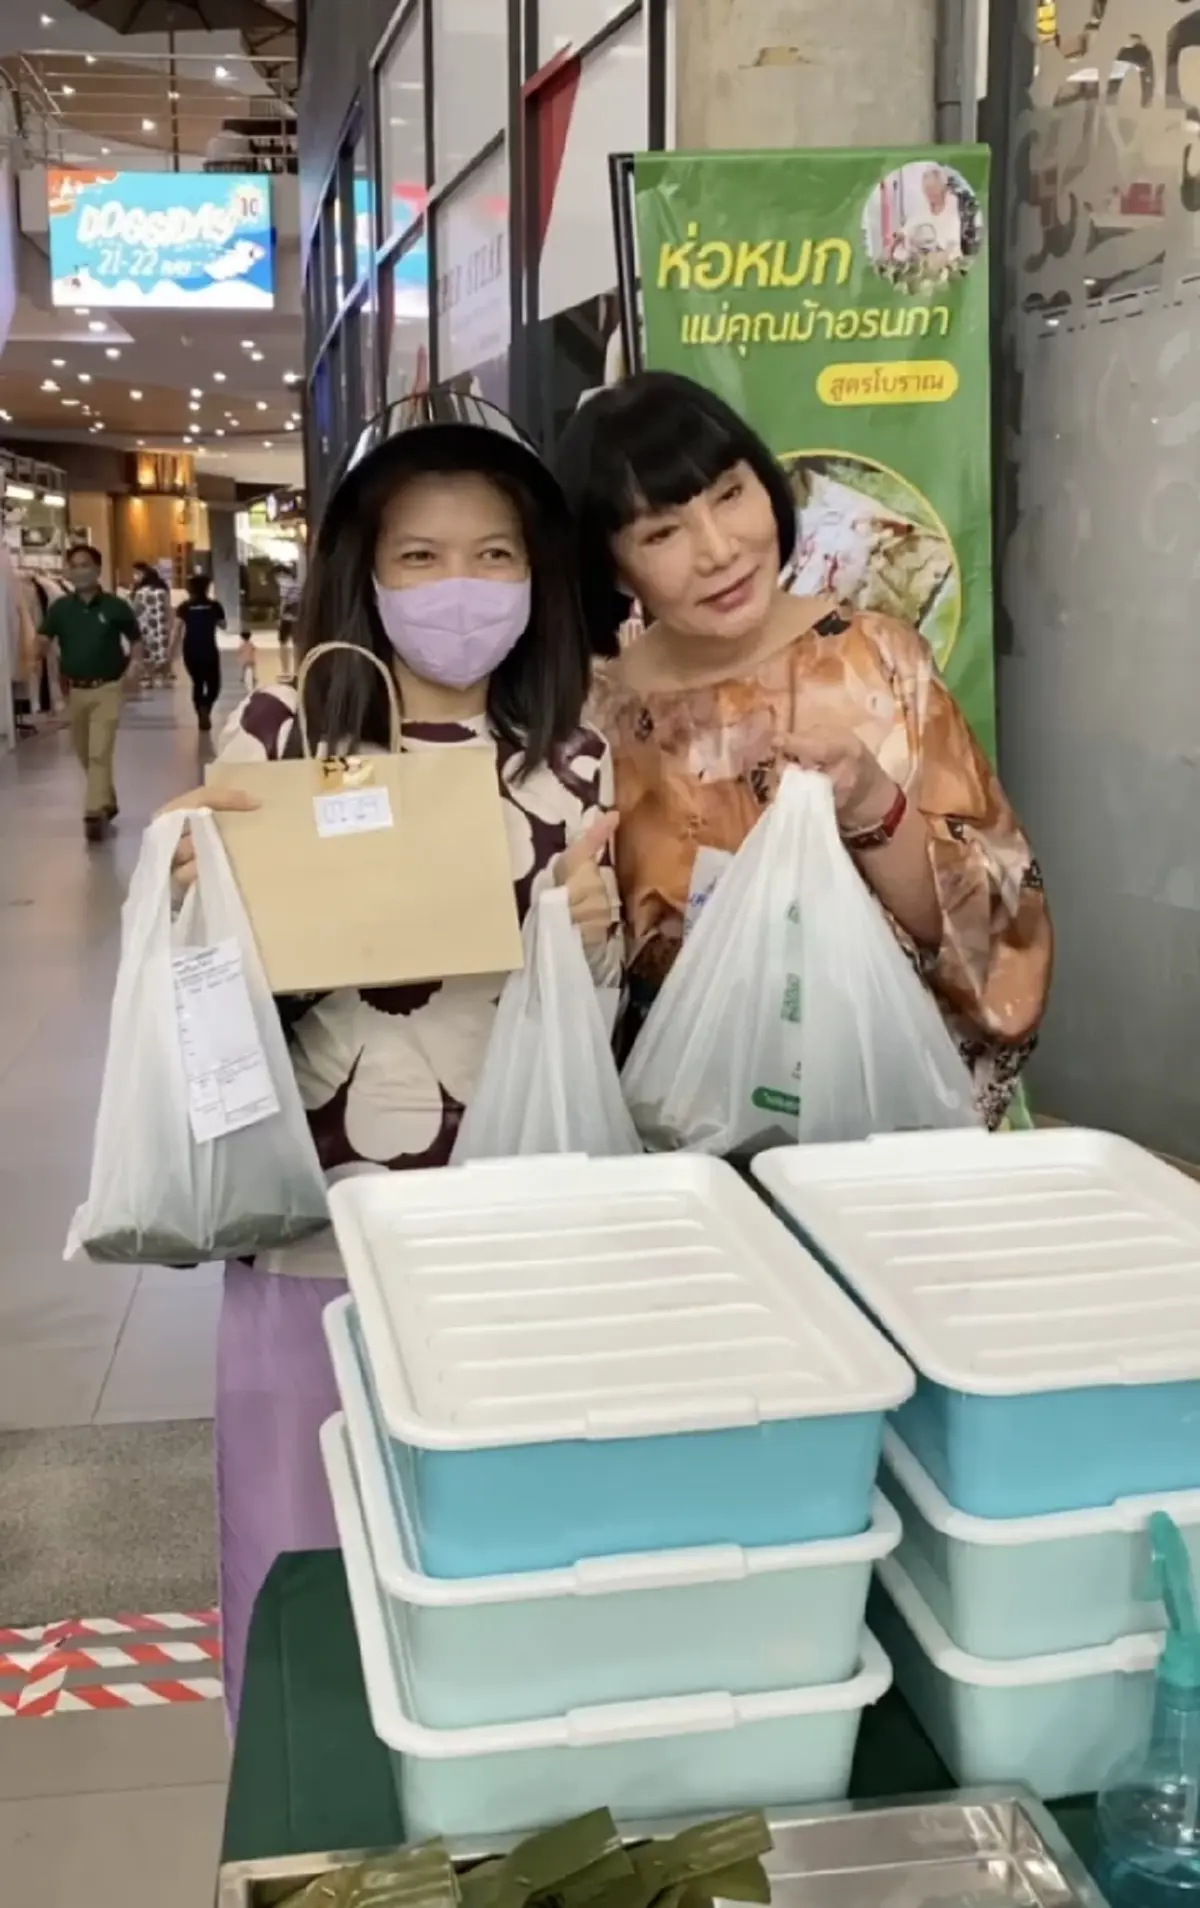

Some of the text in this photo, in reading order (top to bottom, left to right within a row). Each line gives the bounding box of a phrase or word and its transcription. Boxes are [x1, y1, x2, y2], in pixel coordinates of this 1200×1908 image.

[656, 221, 852, 291] ห่อหมก
[680, 300, 950, 357] แม่คุณม้าอรนภา
[829, 366, 945, 402] สูตรโบราณ
